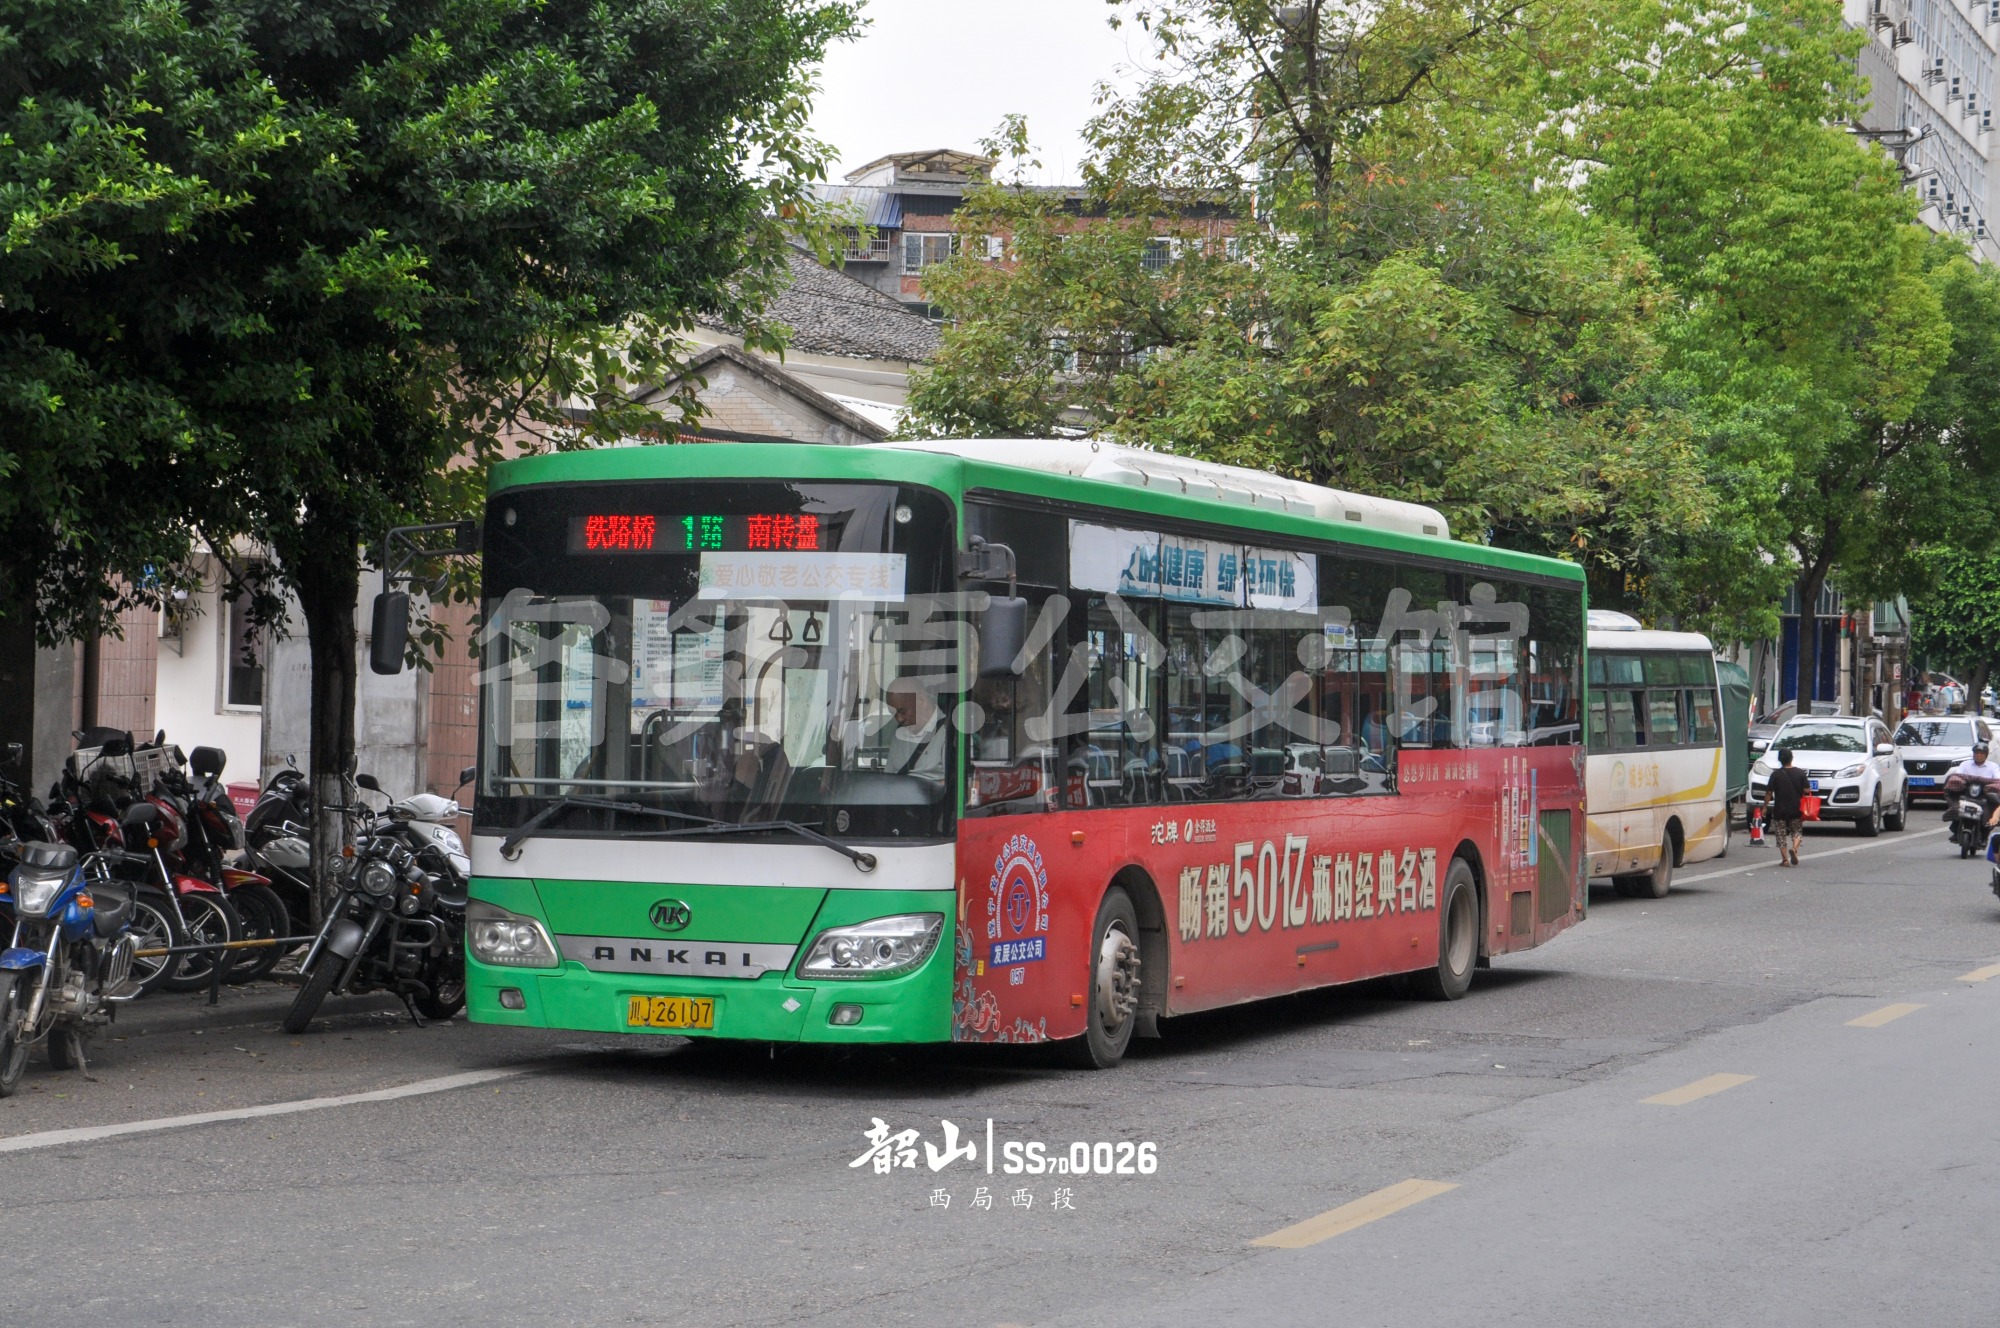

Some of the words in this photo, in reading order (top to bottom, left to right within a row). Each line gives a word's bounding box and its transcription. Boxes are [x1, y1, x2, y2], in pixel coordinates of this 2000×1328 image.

[586, 514, 655, 549] 铁路桥
[747, 513, 819, 549] 南转盘
[714, 563, 890, 590] 爱心敬老公交专线
[1218, 552, 1295, 597] 绿色环保
[1151, 818, 1179, 844] 沱牌
[1179, 832, 1436, 941] 畅销50亿瓶的经典名酒
[594, 946, 751, 967] ANKAI
[993, 939, 1043, 965] 发展公交公司
[1010, 966, 1025, 986] 057
